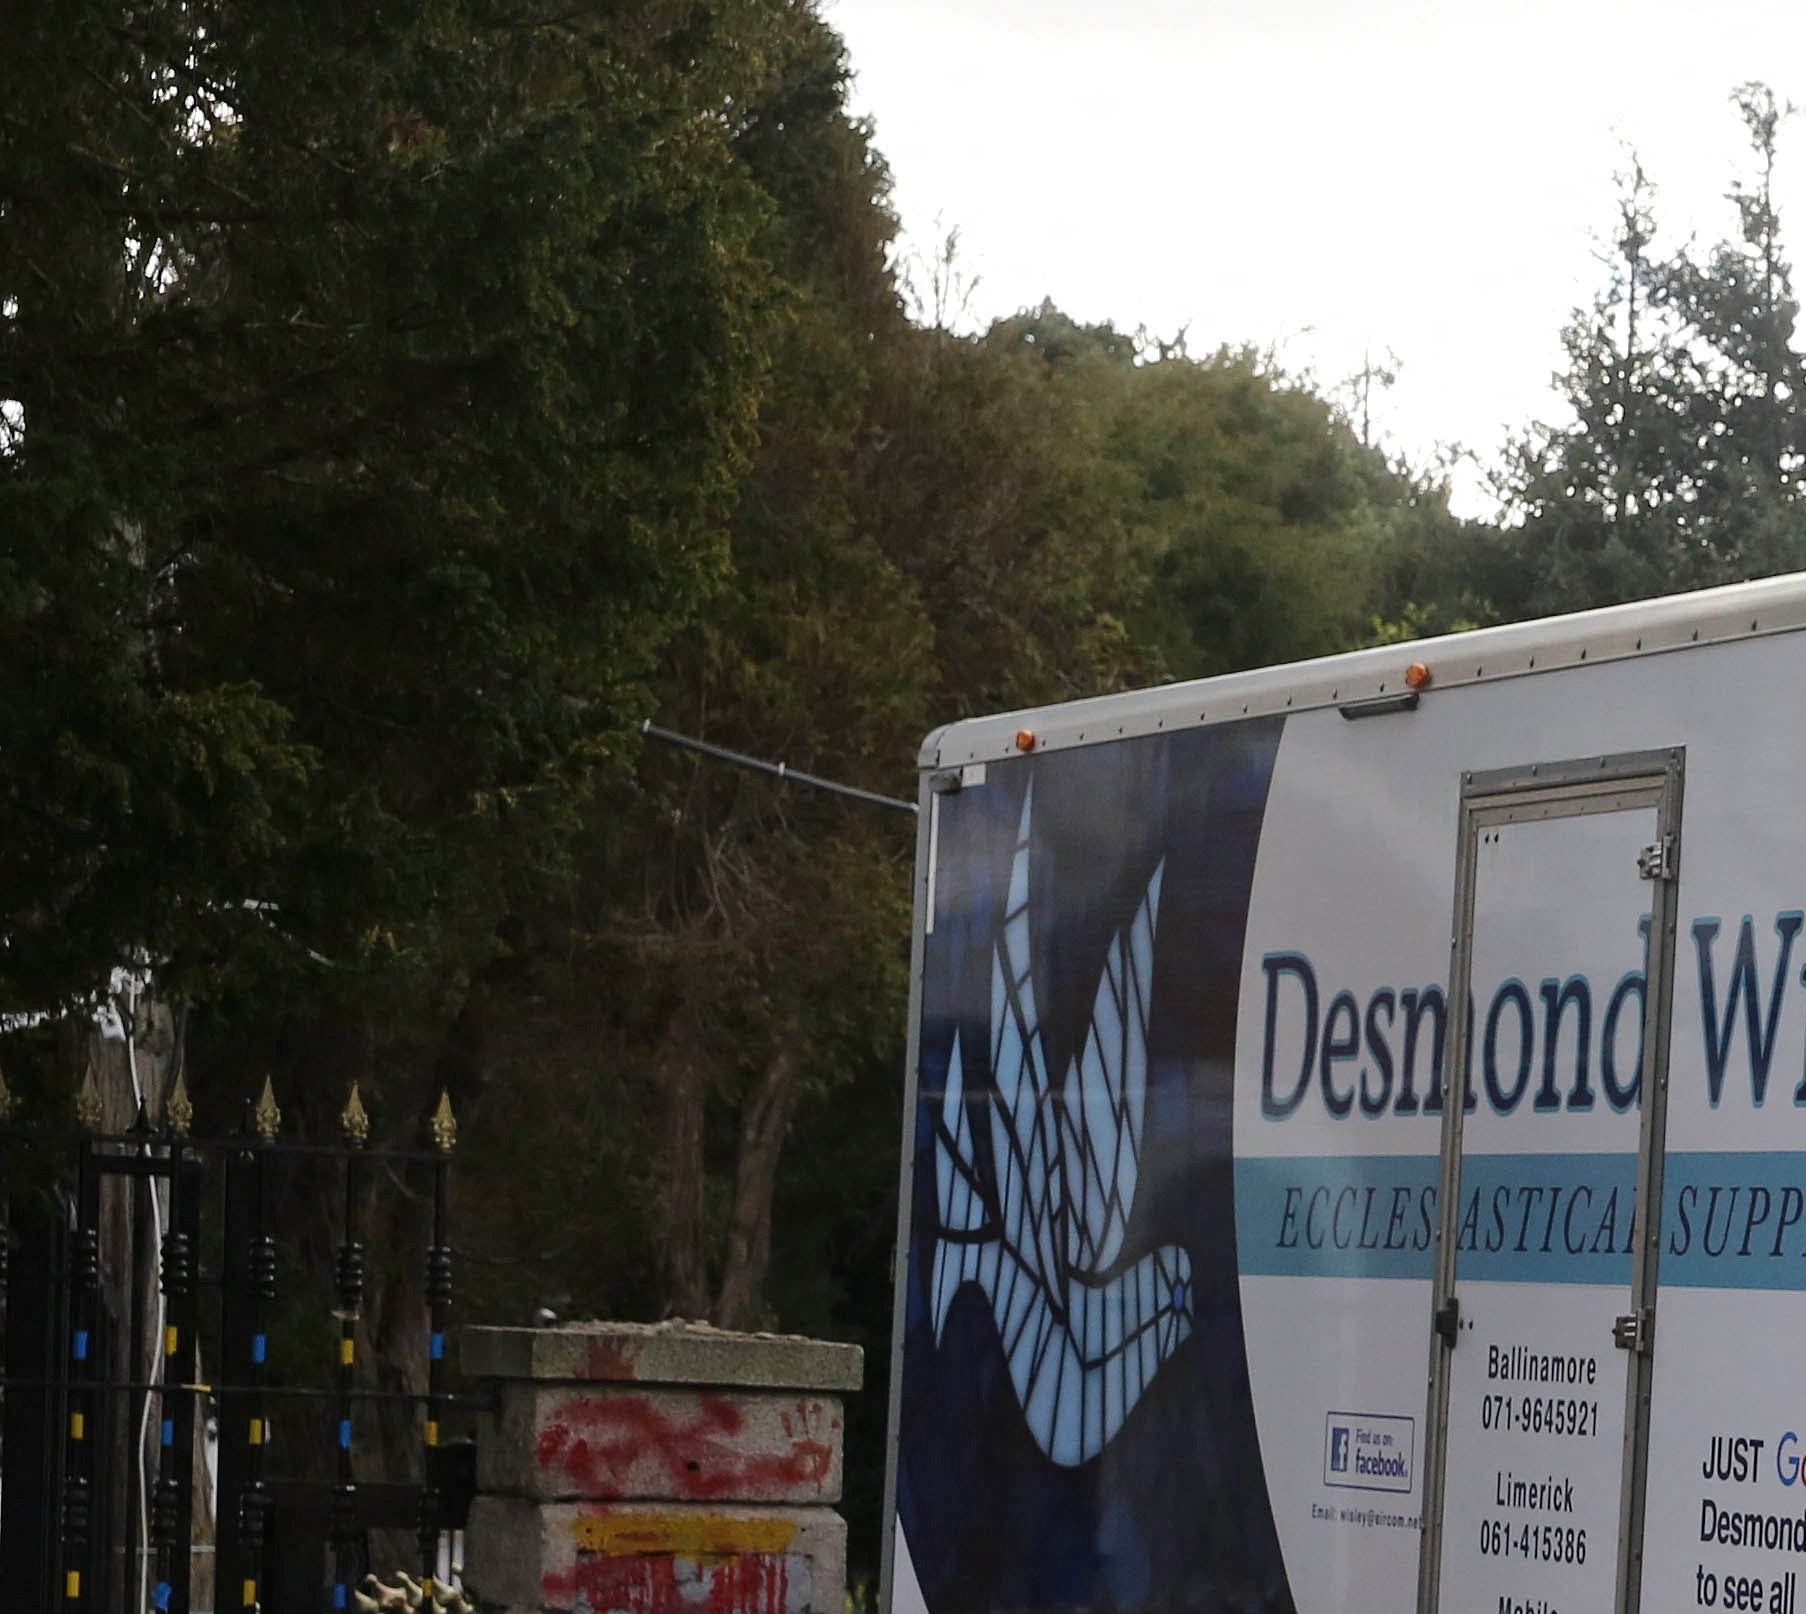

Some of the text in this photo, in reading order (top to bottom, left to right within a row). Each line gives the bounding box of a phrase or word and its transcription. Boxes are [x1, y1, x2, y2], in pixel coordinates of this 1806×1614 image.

[1260, 914, 1652, 1121] Desmond
[1277, 1185, 1637, 1256] ECCLESASTICA
[1488, 1344, 1597, 1385] Ballinamore
[1355, 1429, 1371, 1445] Find
[1373, 1432, 1381, 1445] us
[1482, 1394, 1598, 1437] 071-9645921
[1703, 1436, 1764, 1483] JUST
[1496, 1472, 1574, 1513] Limerick
[1480, 1519, 1586, 1564] 061-415386
[1700, 1499, 1806, 1553] Desmond
[1695, 1564, 1716, 1607] to
[1724, 1574, 1763, 1612] see
